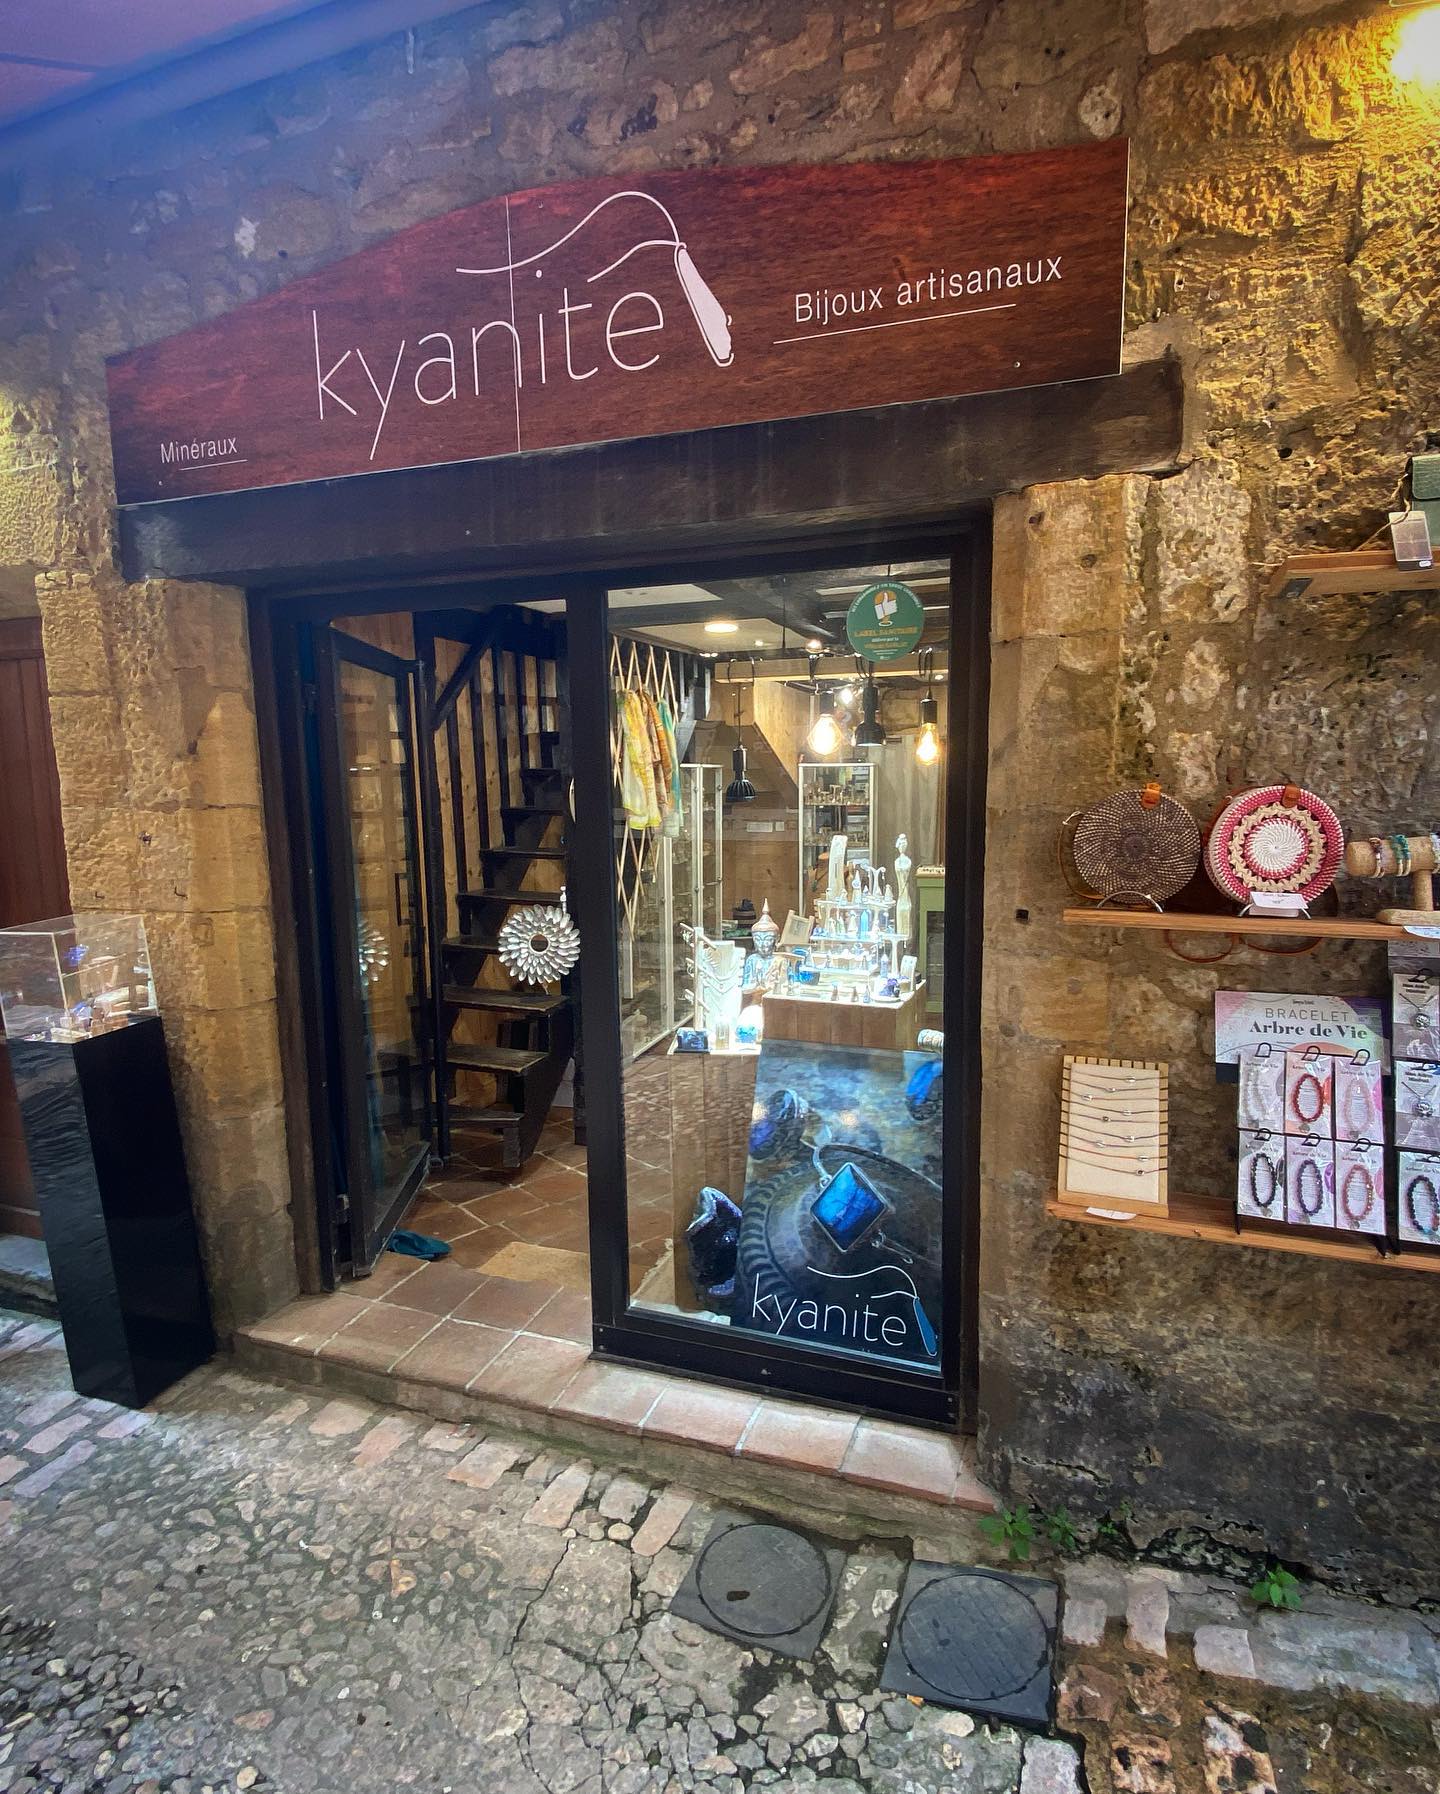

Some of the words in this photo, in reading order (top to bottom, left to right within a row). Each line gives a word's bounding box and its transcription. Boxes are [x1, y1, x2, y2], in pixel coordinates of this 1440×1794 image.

[794, 286, 884, 326] Bijoux
[896, 256, 1063, 306] artisanaux
[311, 269, 665, 461] kyanite
[160, 437, 238, 464] Minéraux
[1249, 1021, 1305, 1036] Arbre
[1309, 1023, 1333, 1038] de
[1336, 1025, 1368, 1040] Vie
[1265, 1007, 1349, 1022] BRACELET
[752, 1272, 907, 1346] kyanite
